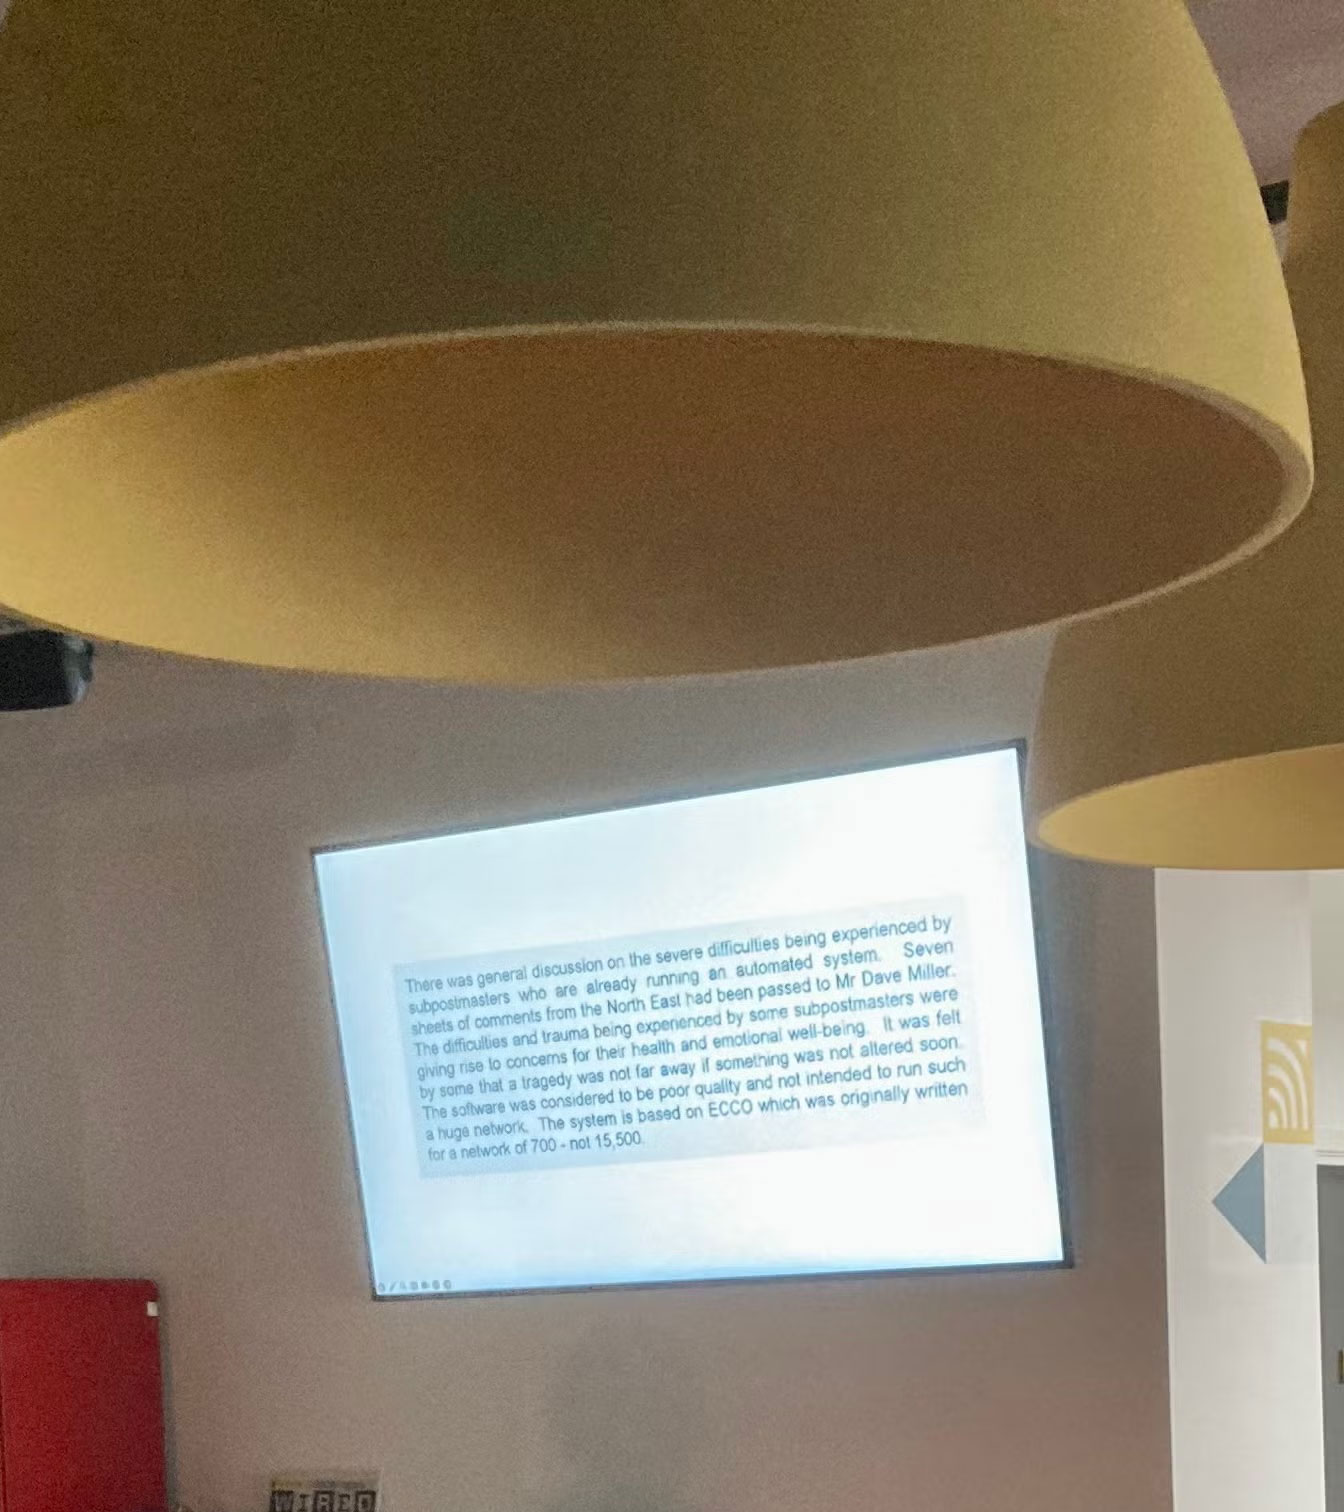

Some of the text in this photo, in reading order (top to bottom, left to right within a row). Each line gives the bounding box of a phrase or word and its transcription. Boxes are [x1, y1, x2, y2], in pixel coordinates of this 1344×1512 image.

[403, 914, 952, 993] There was general discussion on the severe difficulties being experienced by
[407, 991, 511, 1015] subpostmasters
[516, 985, 548, 1002] who
[554, 983, 578, 998] are
[585, 975, 637, 995] already
[645, 969, 700, 988] running
[707, 966, 727, 981] an
[735, 952, 814, 978] automated
[902, 940, 954, 959] Seven
[410, 1018, 454, 1036] sheets
[456, 1013, 470, 1031] of
[473, 1007, 543, 1029] comments
[545, 1005, 577, 1021] from
[579, 1001, 602, 1018] the
[606, 996, 646, 1014] North
[649, 992, 681, 1010] East
[684, 987, 713, 1006] had
[715, 986, 754, 1003] been
[756, 976, 812, 1002] passed
[815, 977, 831, 992] to
[834, 972, 856, 990] Mr
[860, 969, 902, 987] Dave
[413, 987, 959, 1057] The difficulties and trauma being experienced by some subpostmasters were
[416, 1061, 456, 1082] giving
[458, 1060, 484, 1074] rise
[487, 1055, 502, 1071] to
[505, 1051, 568, 1070] concerns
[571, 1046, 591, 1063] for
[594, 1044, 626, 1061] their
[630, 1038, 676, 1057] health
[680, 1034, 708, 1053] and
[711, 1027, 783, 1049] emotional
[881, 1015, 894, 1032] It
[897, 1014, 931, 1030] was
[935, 1008, 961, 1027] felt
[418, 1084, 435, 1103] by
[438, 1082, 474, 1098] some
[477, 1077, 504, 1094] that
[507, 1078, 518, 1092] a
[520, 1071, 573, 1092] tragedy
[575, 1070, 605, 1085] was
[608, 1065, 632, 1082] not
[634, 1063, 655, 1079] far
[659, 1061, 696, 1078] away
[700, 1056, 710, 1074] if
[714, 1052, 790, 1072] something
[792, 1048, 824, 1064] was
[828, 1042, 855, 1061] not
[859, 1037, 914, 1058] altered
[420, 1055, 966, 1121] The software was considered to be poor quality and not intended to run such
[424, 1129, 435, 1141] a
[436, 1125, 470, 1143] huge
[537, 1115, 565, 1131] The
[568, 1112, 618, 1133] system
[620, 1109, 633, 1125] is
[636, 1104, 681, 1123] based
[684, 1105, 704, 1119] on
[707, 1097, 754, 1118] ECCO
[756, 1095, 801, 1113] which
[804, 1094, 836, 1109] was
[839, 1084, 910, 1108] originally
[913, 1081, 968, 1099] written
[426, 1147, 446, 1162] for
[447, 1148, 458, 1161] a
[459, 1141, 512, 1159] network
[513, 1139, 528, 1155] of
[529, 1137, 557, 1153] 700
[568, 1135, 591, 1150] not
